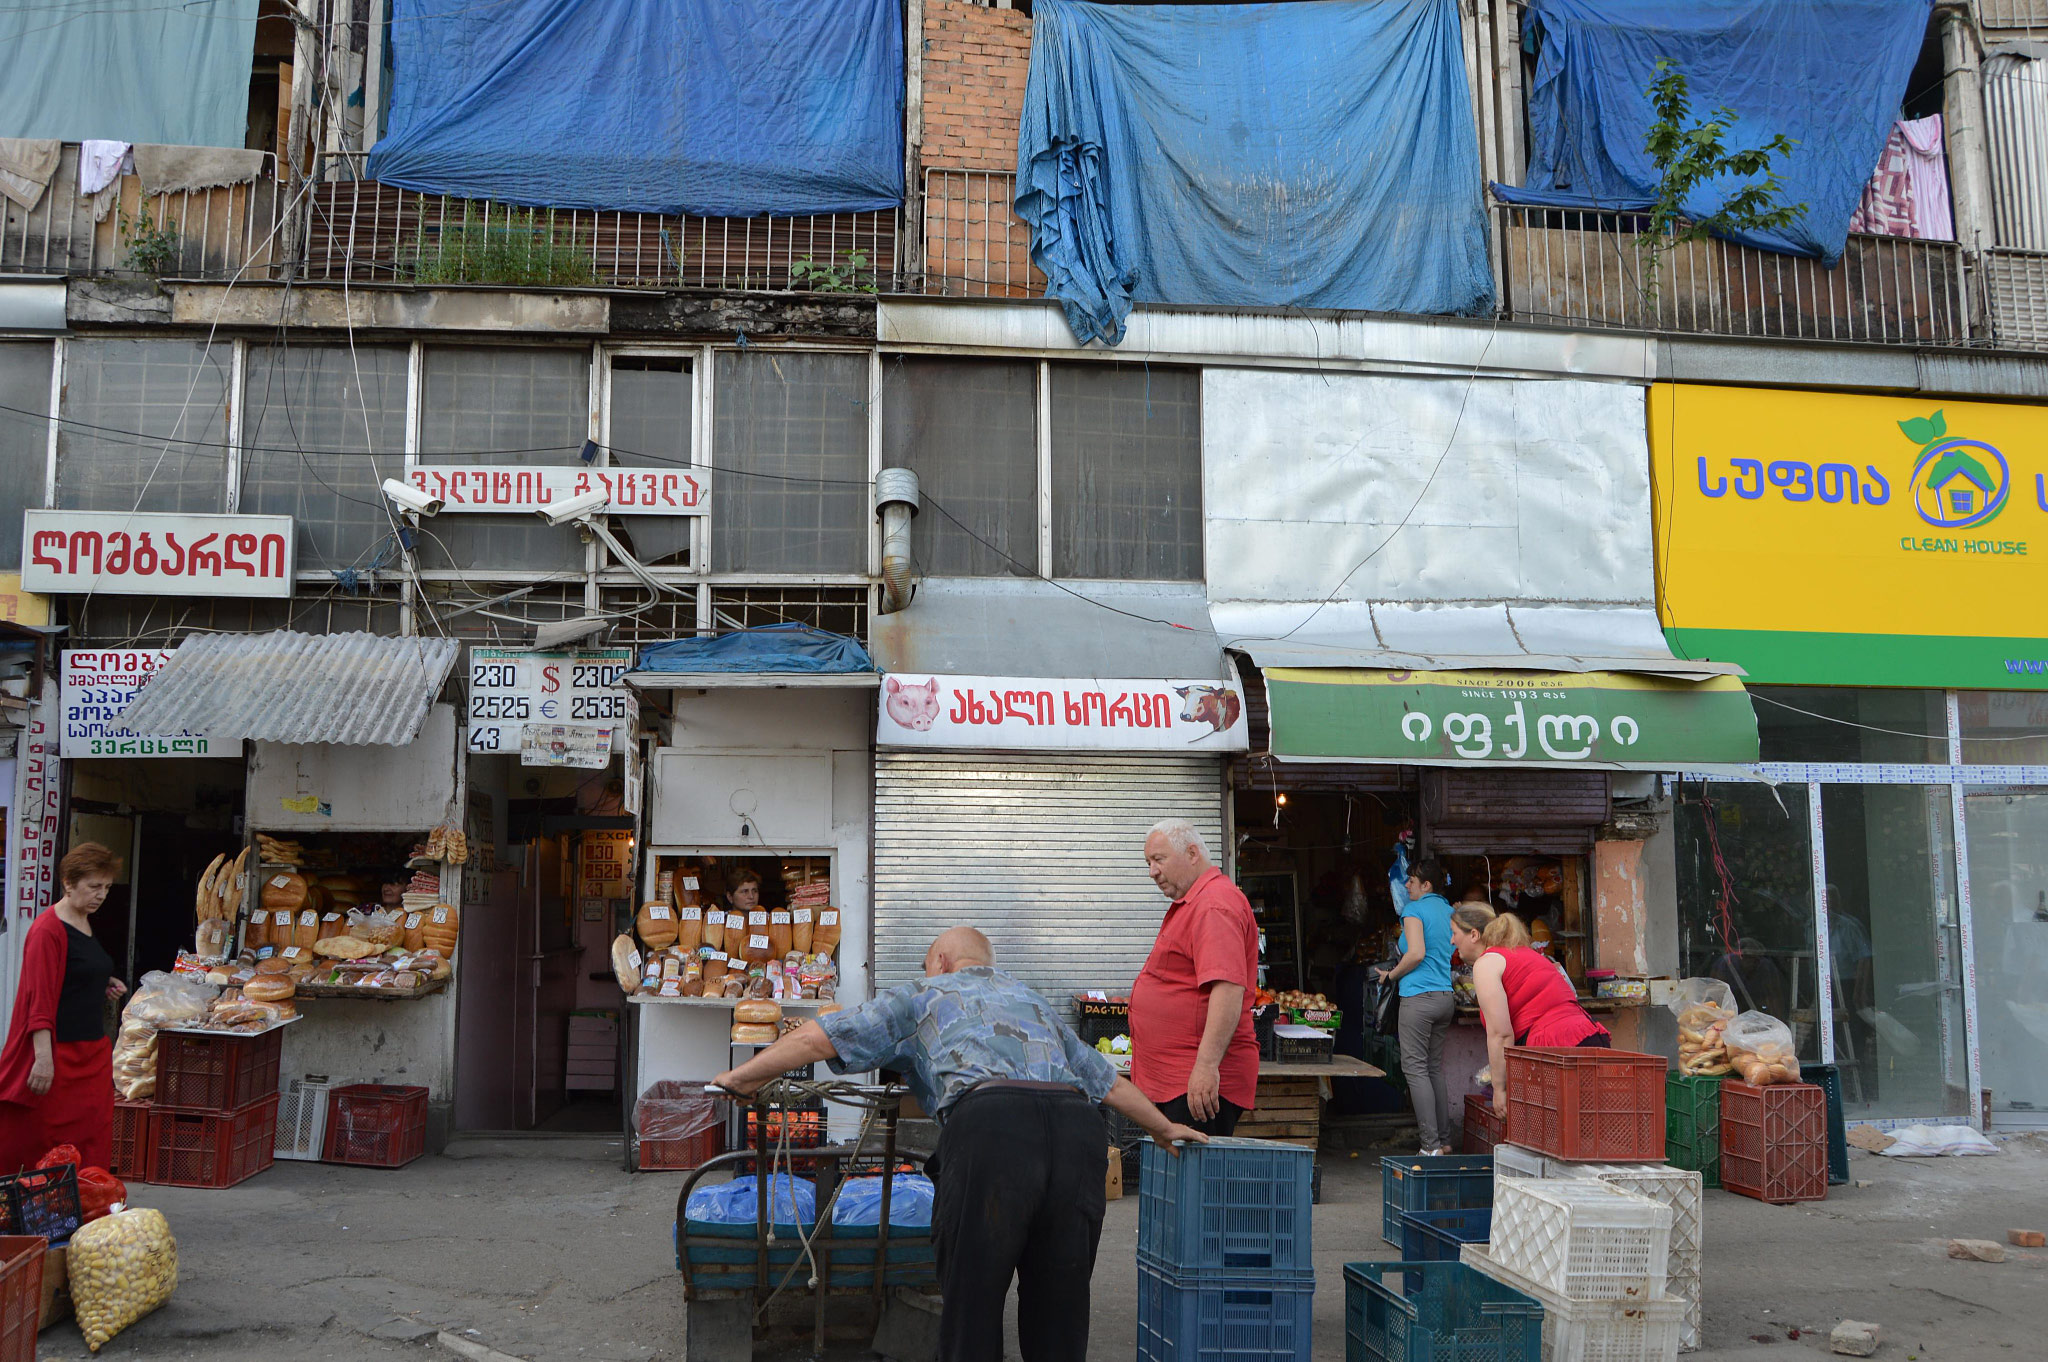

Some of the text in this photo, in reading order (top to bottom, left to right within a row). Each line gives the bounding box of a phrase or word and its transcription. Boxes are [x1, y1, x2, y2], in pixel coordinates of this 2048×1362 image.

[411, 471, 699, 507] ვალუტის გაცვლა
[1697, 456, 1891, 506] სუფთა
[32, 529, 286, 579] ლომბარდი
[1900, 536, 2028, 556] CLEAN HOUSE
[70, 653, 171, 672] ლომბა
[2004, 658, 2048, 674] ww
[473, 665, 516, 688] 230
[1496, 679, 1535, 688] 2006
[472, 696, 530, 720] 2525
[571, 696, 625, 720] 2535
[1461, 689, 1567, 701] SINCE 1993 დან
[950, 688, 1173, 730] ახალი ხორცი
[1946, 705, 1954, 732] SARAY
[470, 727, 500, 751] 43
[1401, 700, 1640, 761] იფქლი
[27, 720, 45, 792] ახალ
[90, 739, 208, 755] ვერცხლი
[1815, 804, 1823, 830] SARAY
[1957, 797, 1966, 822] SARAY
[39, 790, 59, 908] ლომბა
[596, 832, 634, 841] EXCH
[1812, 849, 1820, 876] SARAY
[1955, 841, 1963, 867] SARAY
[1820, 888, 1828, 915] SARAY
[1963, 879, 1971, 905] SARAY
[277, 914, 289, 925] 75
[302, 915, 315, 926] 50
[1817, 934, 1825, 960] SARAY
[1961, 924, 1969, 951] SARAY
[1824, 974, 1832, 1001] SARAY
[1968, 963, 1976, 989] SARAY
[1821, 1020, 1829, 1047] SARAY
[1966, 1008, 1974, 1034] SARAY
[1973, 1047, 1981, 1073] SARAY
[1970, 1092, 1978, 1119] SARAY
